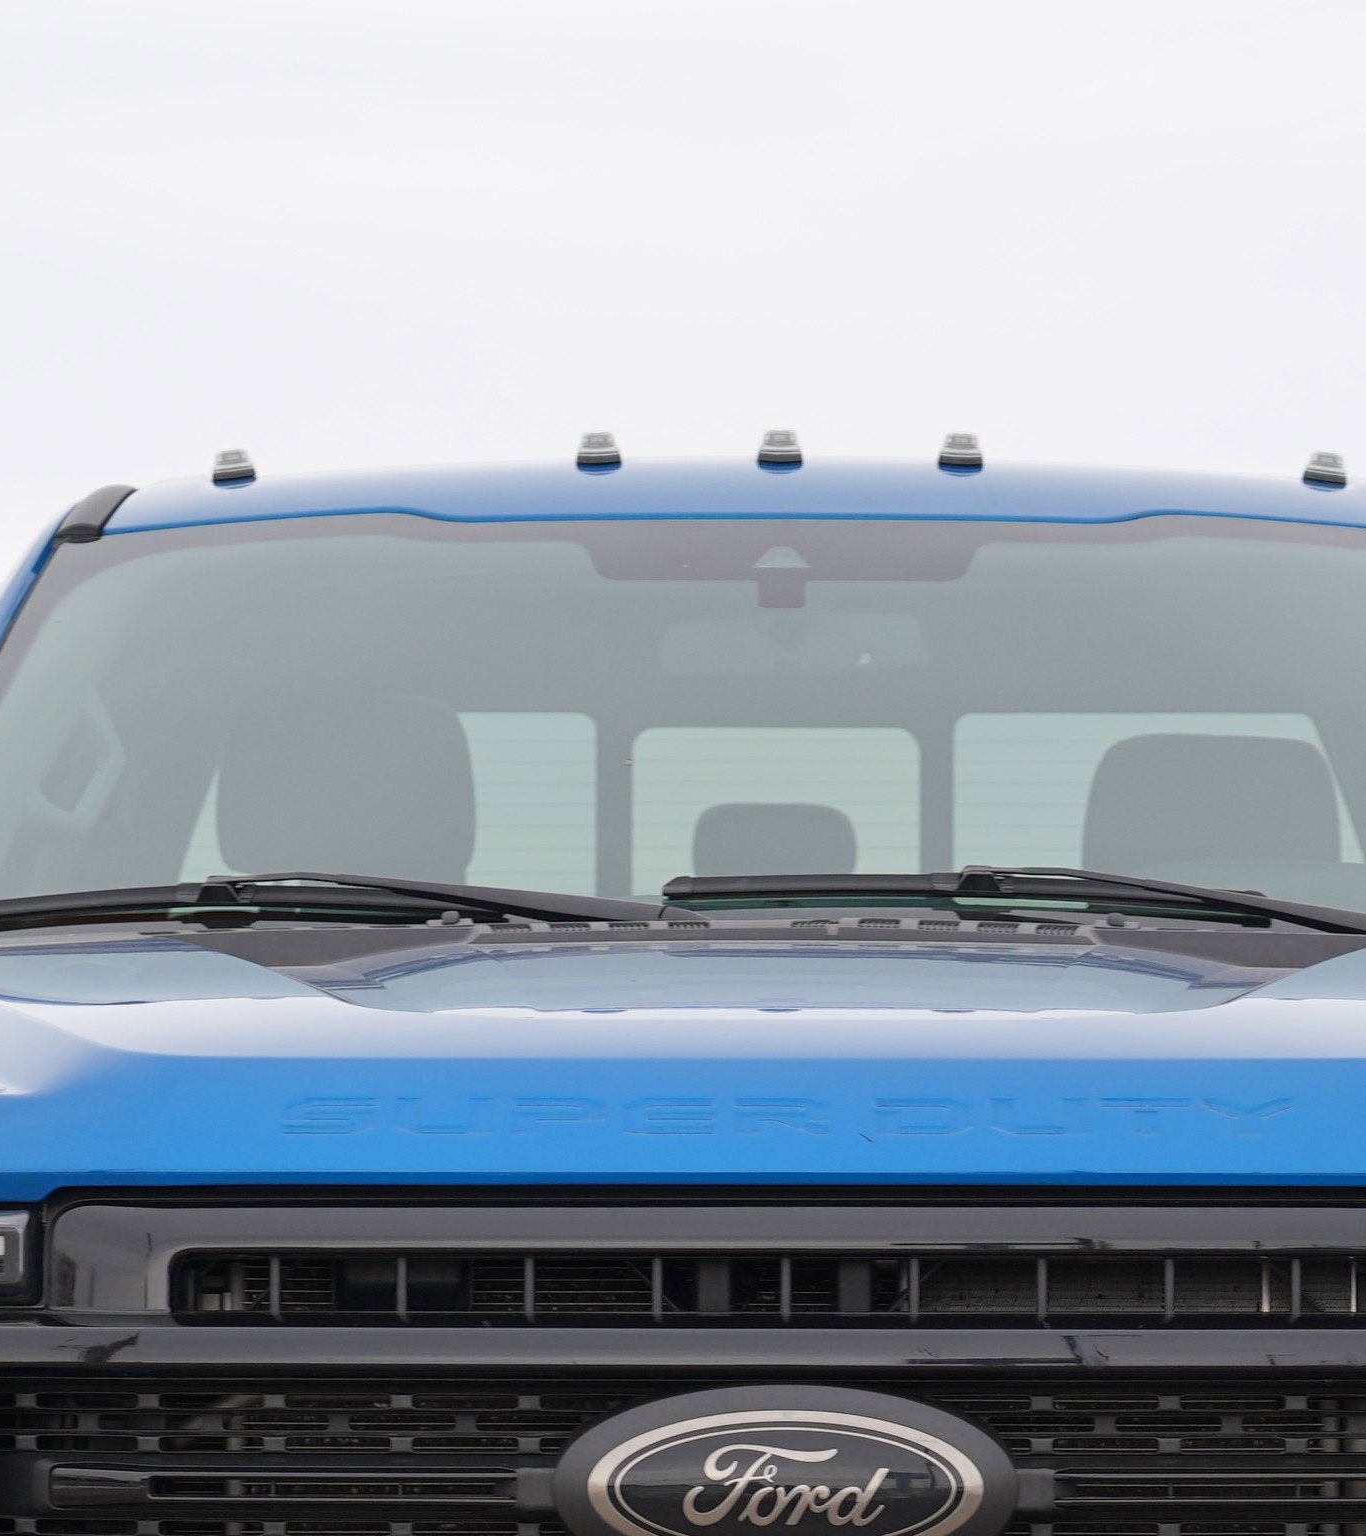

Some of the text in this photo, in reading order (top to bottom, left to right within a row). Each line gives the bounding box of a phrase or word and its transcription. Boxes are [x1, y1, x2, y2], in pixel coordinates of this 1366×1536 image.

[280, 1097, 1293, 1136] SUPER DUTY
[682, 1443, 890, 1527] Ford
